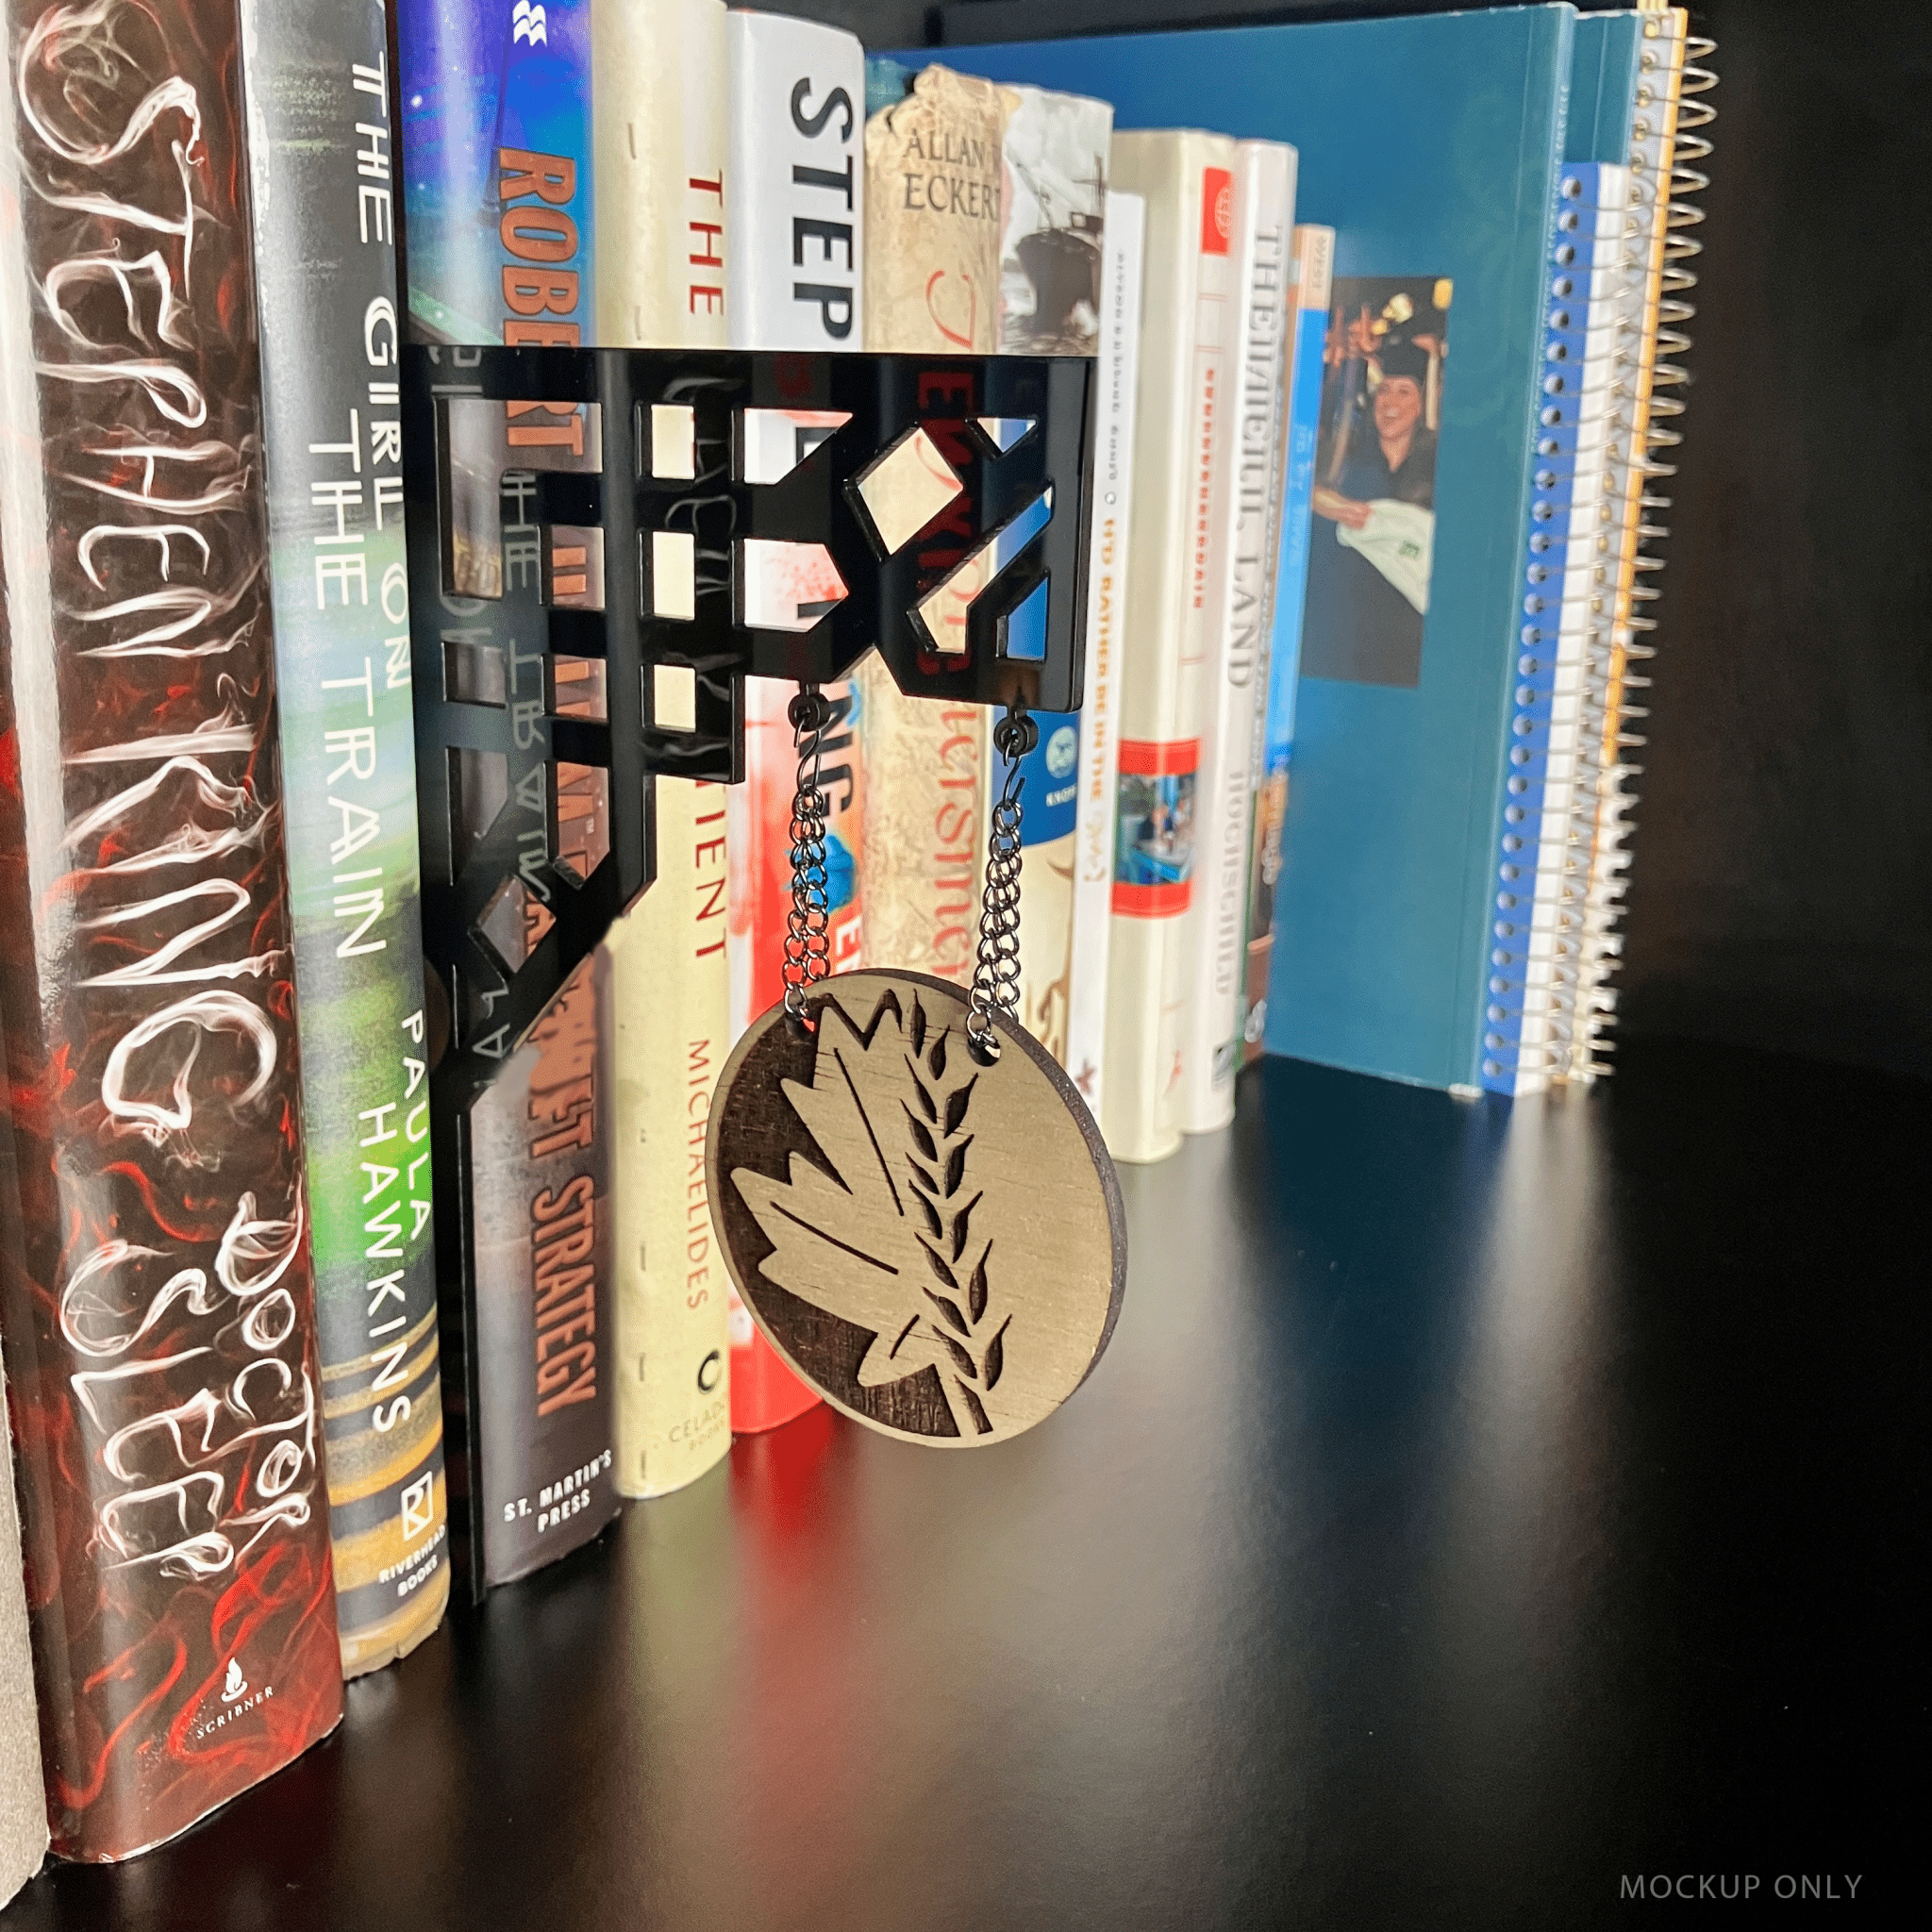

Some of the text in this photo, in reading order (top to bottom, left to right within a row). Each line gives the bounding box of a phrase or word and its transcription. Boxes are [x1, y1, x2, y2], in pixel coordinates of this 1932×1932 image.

[689, 170, 724, 316] THE
[903, 128, 985, 169] ALLAN
[352, 51, 413, 689] THE GIRL ON
[19, 2, 285, 1113] STEPHEN KING
[309, 408, 388, 958] THE TRAIN
[401, 1008, 432, 1241] PAULA
[686, 1039, 709, 1310] MICHAELIDES
[209, 1173, 317, 1571] DOCTOR
[358, 1102, 411, 1433] HAWKINS
[533, 1175, 597, 1417] STRATEGY
[61, 1240, 236, 1579] SLEEP
[503, 1451, 612, 1522] ST. MARTIN'S
[537, 1489, 591, 1533] PRESS
[378, 1524, 446, 1585] RIVERHEAD
[397, 1554, 438, 1598] BOOKS
[196, 1686, 274, 1740] SCRIBNER
